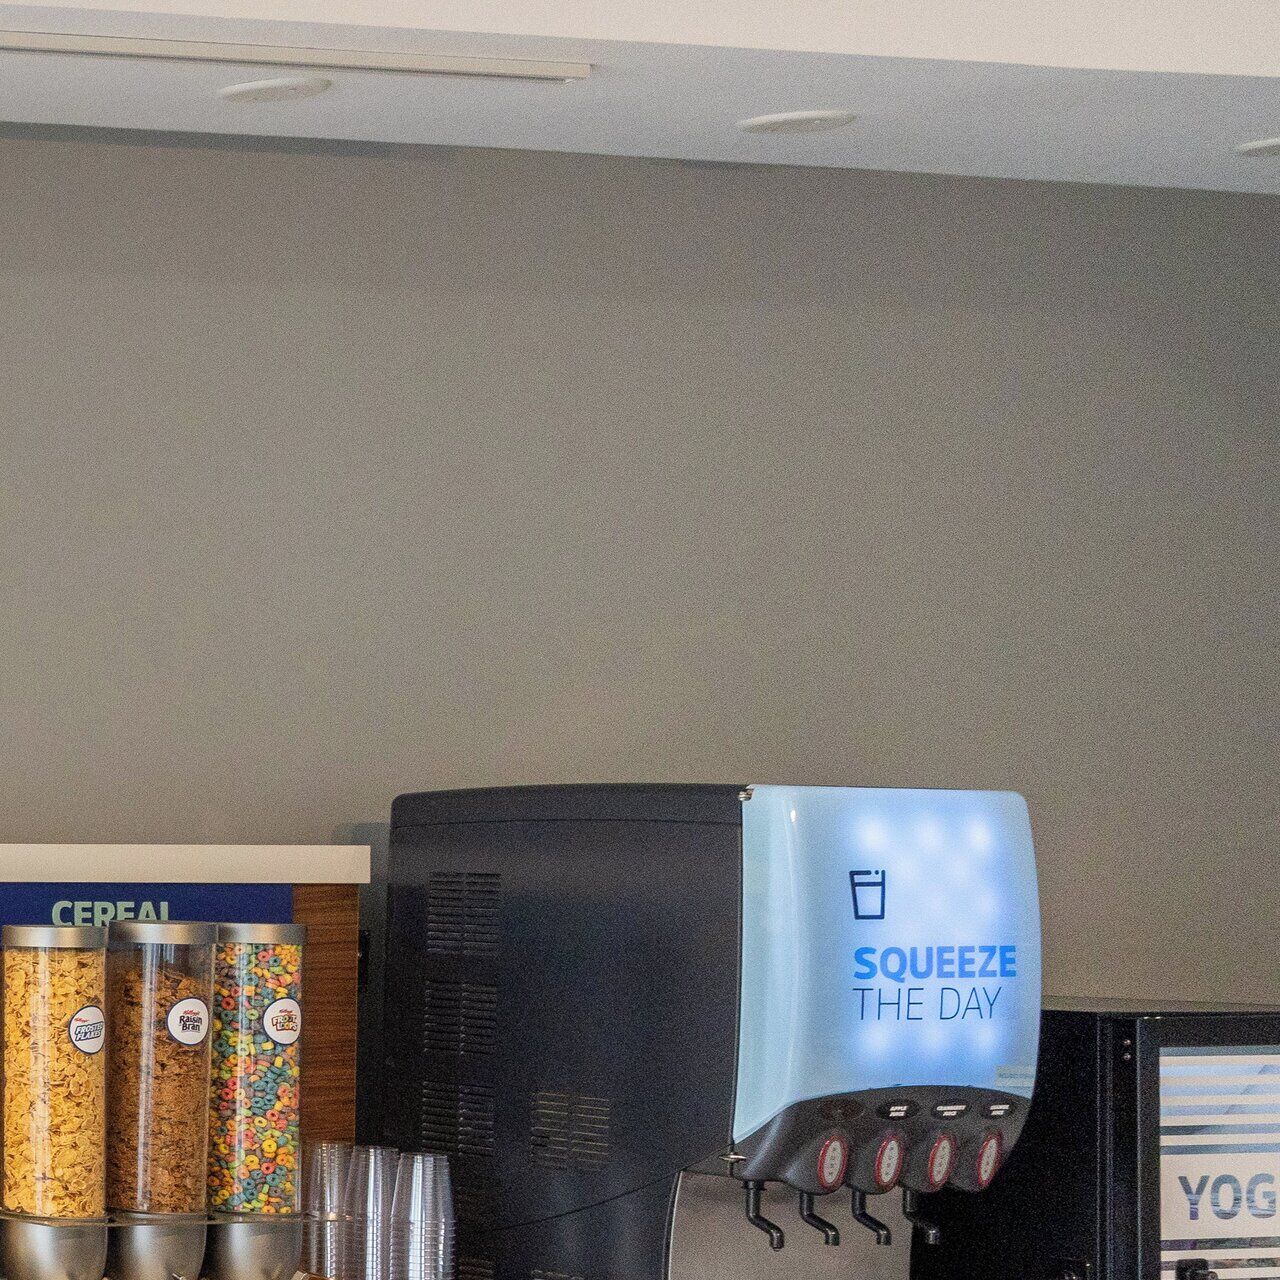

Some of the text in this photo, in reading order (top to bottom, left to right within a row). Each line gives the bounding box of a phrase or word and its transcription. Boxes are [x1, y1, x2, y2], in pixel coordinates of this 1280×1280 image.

[853, 945, 1017, 983] SQUEEZE
[852, 986, 1002, 1021] THE DAY
[179, 1015, 203, 1025] Raisin
[181, 1022, 201, 1031] Bran
